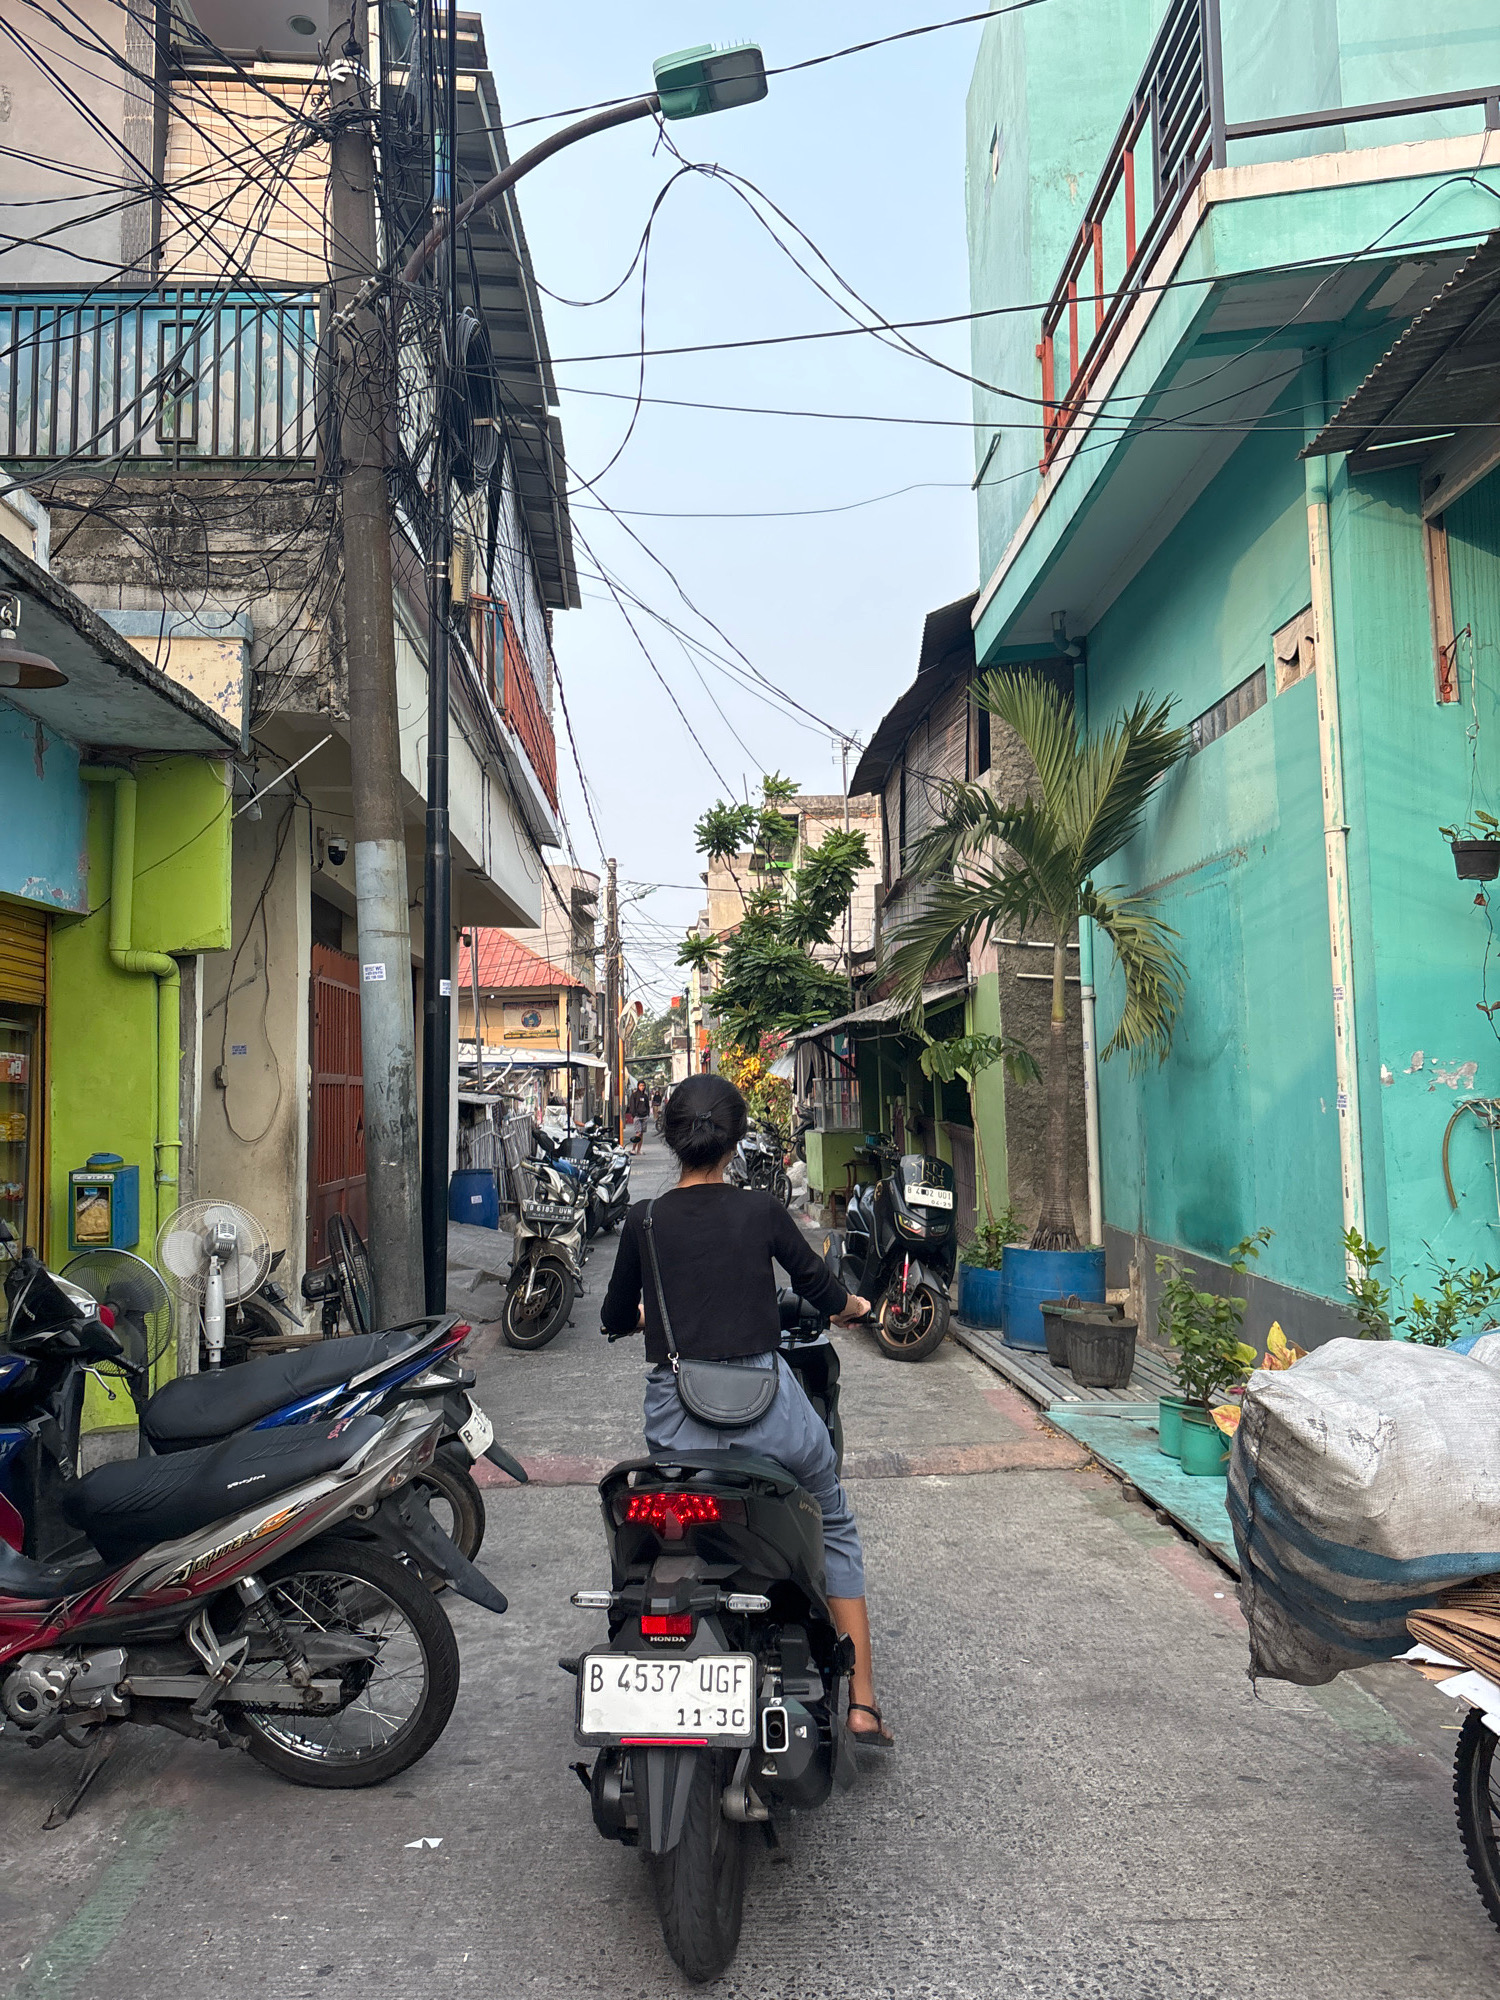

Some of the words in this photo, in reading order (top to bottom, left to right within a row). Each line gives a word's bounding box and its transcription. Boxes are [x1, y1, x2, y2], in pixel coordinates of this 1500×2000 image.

[590, 1663, 604, 1693] B
[617, 1663, 681, 1692] 4537
[699, 1664, 746, 1693] UGF
